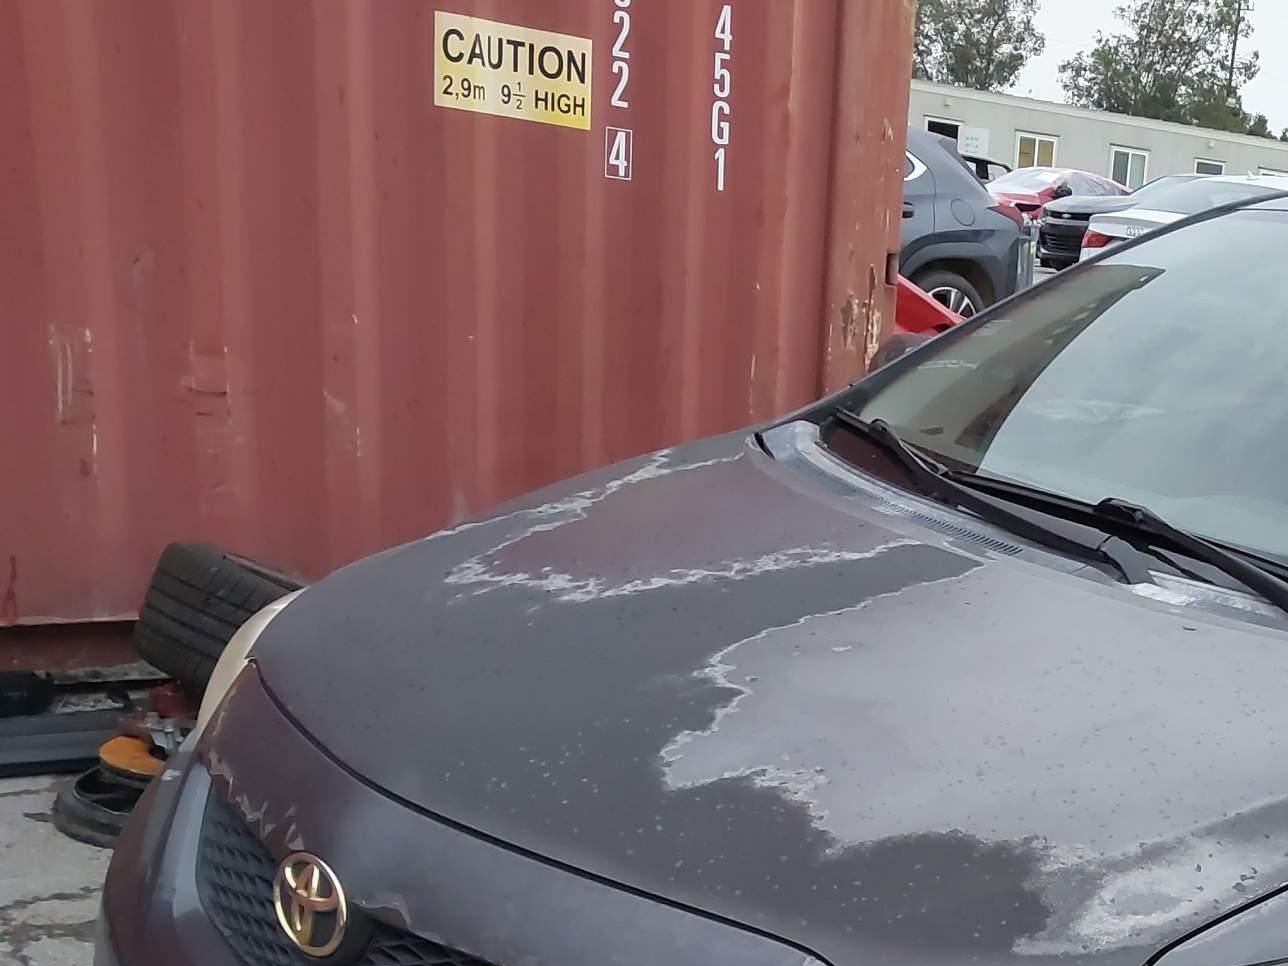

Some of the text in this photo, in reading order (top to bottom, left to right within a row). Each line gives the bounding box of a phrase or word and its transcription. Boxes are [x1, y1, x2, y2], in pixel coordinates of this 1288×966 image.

[442, 28, 586, 84] CAUTION
[442, 75, 486, 101] 2,9m
[534, 89, 586, 117] HIGH
[608, 0, 631, 177] 22 4
[712, 4, 733, 191] 45G1
